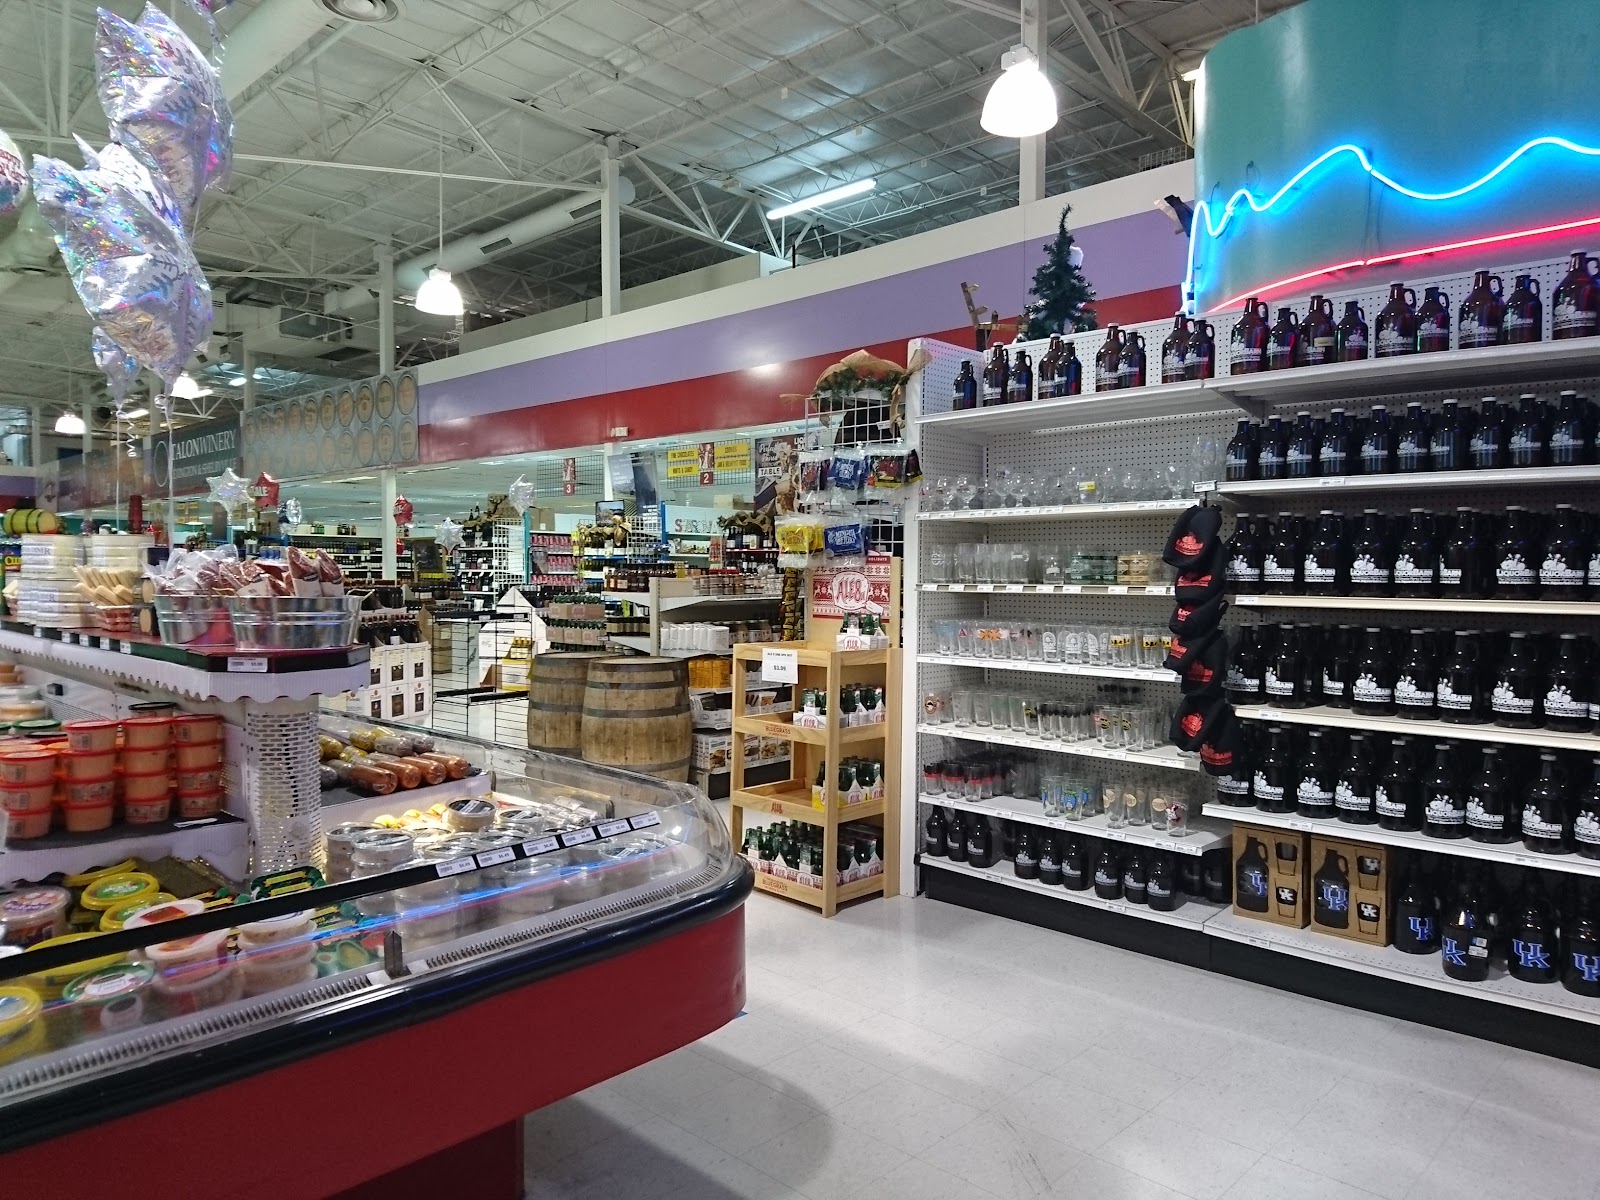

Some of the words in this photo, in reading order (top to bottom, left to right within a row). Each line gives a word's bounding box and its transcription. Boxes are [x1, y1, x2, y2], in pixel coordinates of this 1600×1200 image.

[761, 468, 780, 476] TABLE
[703, 473, 709, 483] 2
[566, 485, 572, 494] 3
[765, 726, 791, 735] BLUEGRASS
[762, 878, 788, 892] BLUEGRASS
[1361, 903, 1378, 918] UK
[1512, 938, 1551, 969] UK
